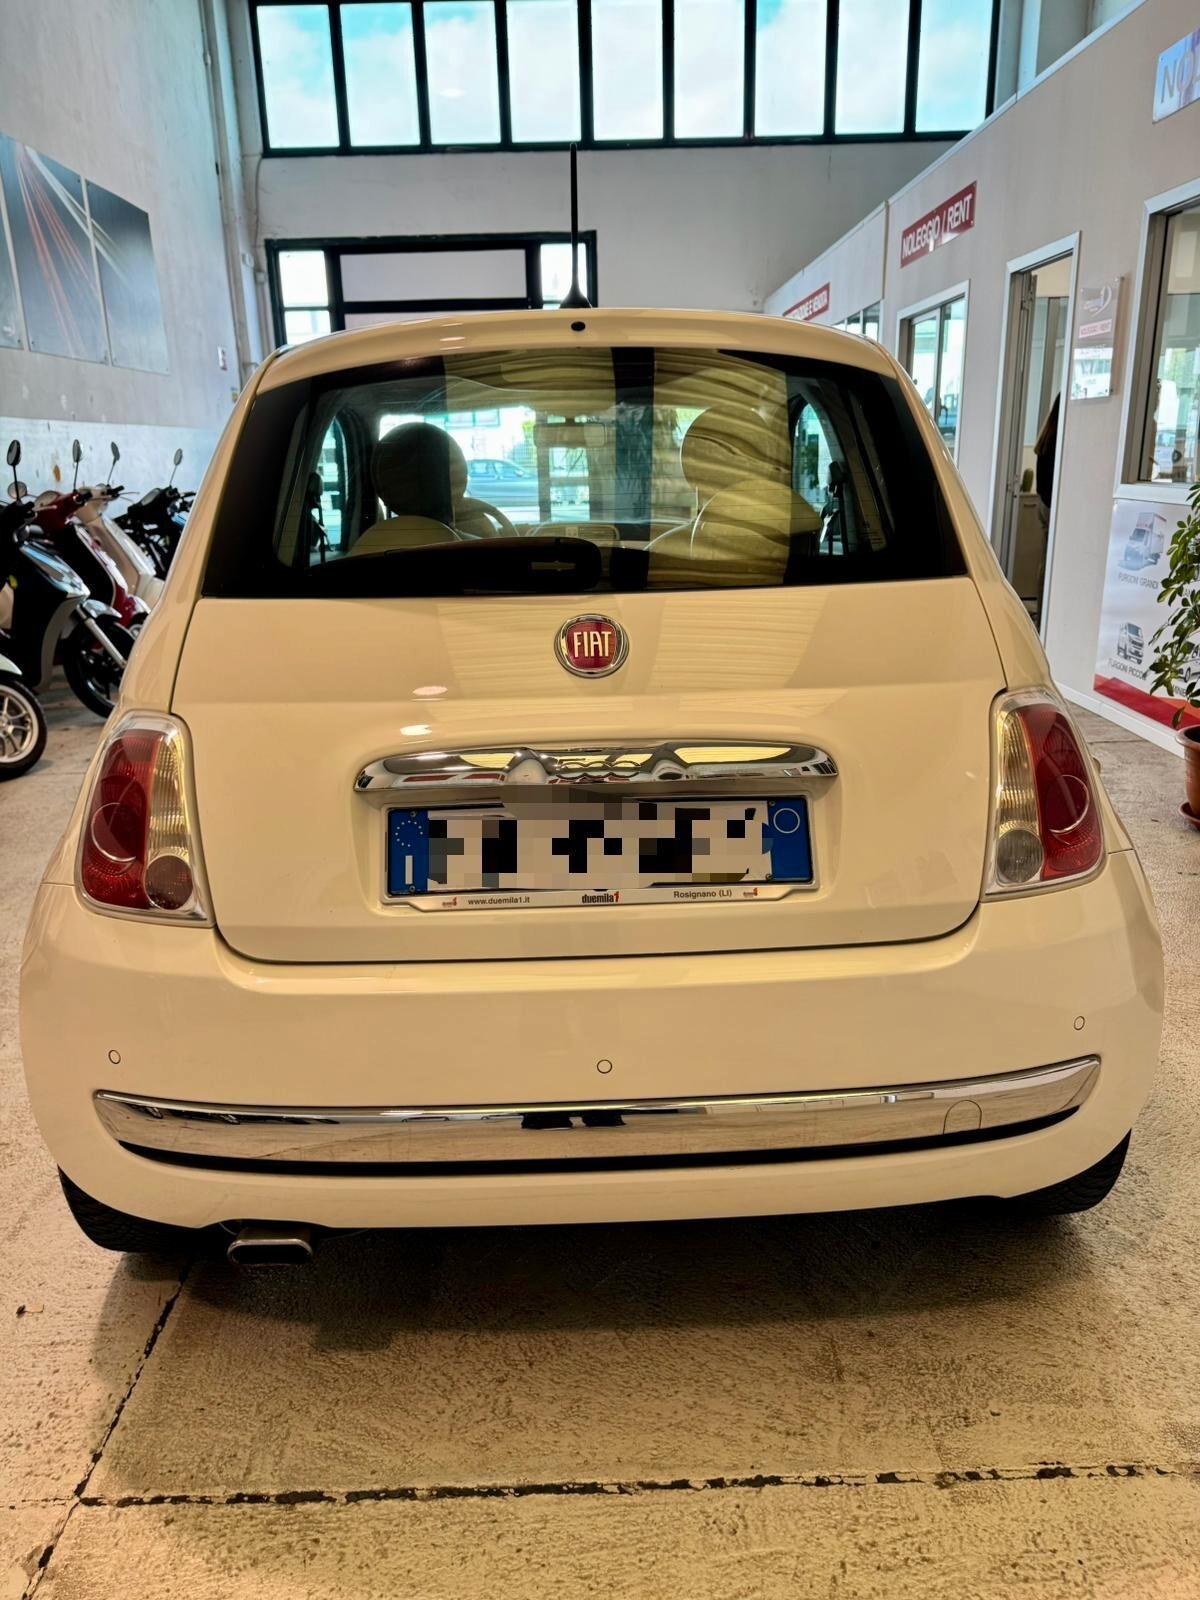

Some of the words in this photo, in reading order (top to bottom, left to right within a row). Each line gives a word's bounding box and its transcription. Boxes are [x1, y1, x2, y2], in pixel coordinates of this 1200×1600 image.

[902, 215, 940, 259] NOLEGGIO
[947, 193, 973, 231] RENT
[573, 631, 612, 658] FIAT
[581, 891, 620, 904] duemila1
[673, 889, 717, 899] Rosignano
[718, 888, 733, 898] (LI)
[468, 896, 530, 905] www.duemila1.it
